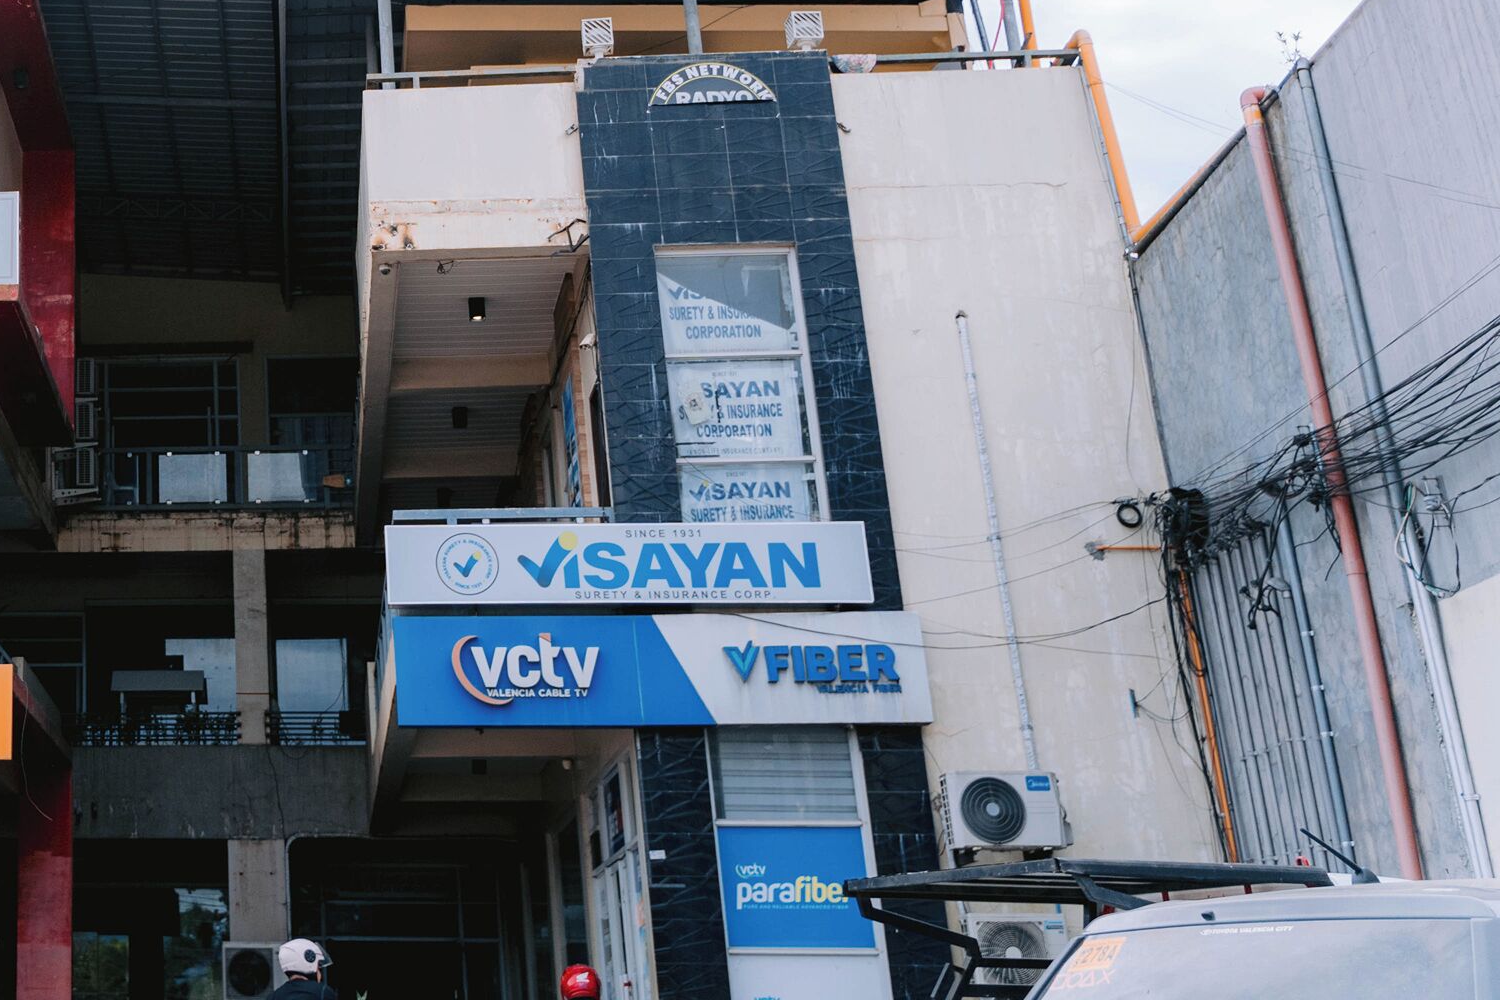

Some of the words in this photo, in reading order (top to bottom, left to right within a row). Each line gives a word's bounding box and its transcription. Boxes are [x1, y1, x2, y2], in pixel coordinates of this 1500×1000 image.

[685, 64, 773, 101] NETWORK
[669, 306, 704, 320] SURETY
[708, 305, 715, 320] &
[686, 325, 761, 339] CORPORATION
[701, 380, 780, 398] SAYAN
[727, 403, 783, 419] INSURANCE
[696, 423, 772, 437] CORPORATION
[690, 506, 727, 522] SURETY
[730, 505, 737, 521] &
[740, 504, 795, 521] INSURANCE
[625, 529, 666, 538] SINCE
[672, 528, 702, 538] 1931
[574, 590, 629, 600] SURETY
[634, 590, 642, 599] &
[648, 590, 731, 599] INSURANCE
[734, 589, 777, 599] CORP.
[470, 632, 600, 688] vctv
[486, 688, 535, 698] VALENCIA
[538, 687, 571, 698] CABLE
[574, 687, 588, 697] TV
[816, 684, 869, 694] VALENCIA
[872, 683, 902, 694] FIBER
[739, 863, 766, 876] vctv
